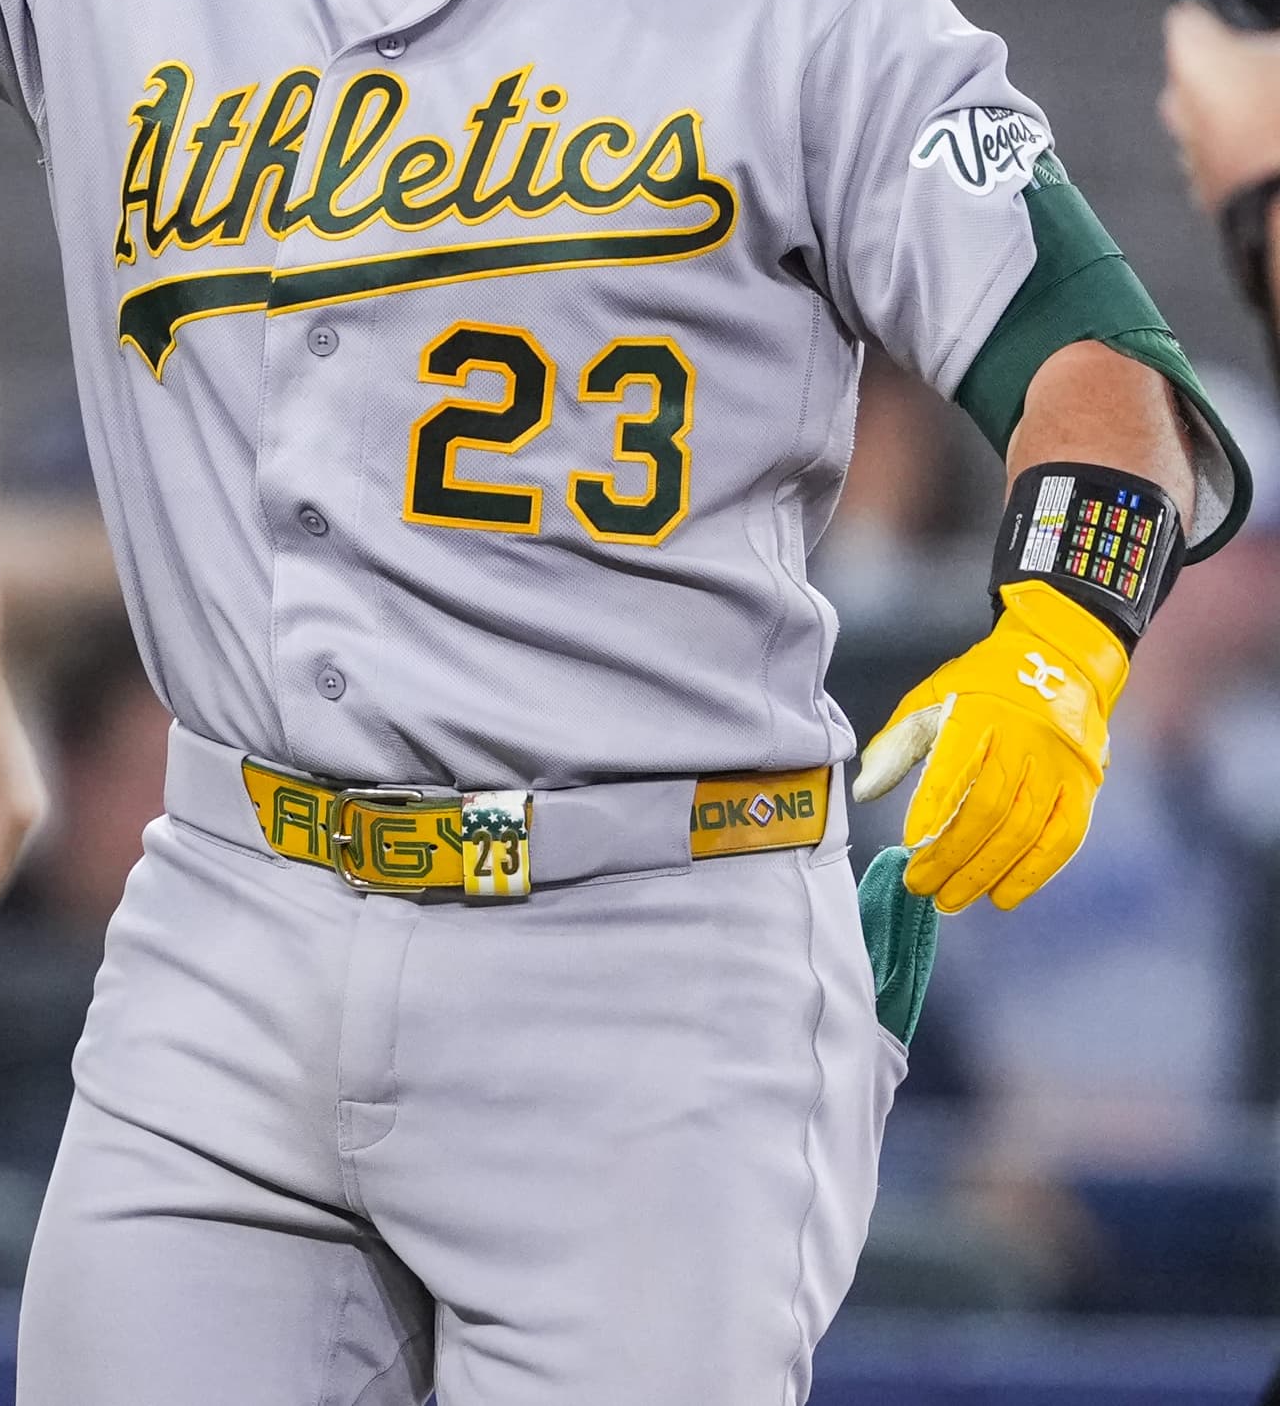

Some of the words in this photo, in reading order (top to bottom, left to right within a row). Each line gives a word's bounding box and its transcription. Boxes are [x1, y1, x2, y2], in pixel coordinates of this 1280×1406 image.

[115, 59, 737, 270] Athletics
[918, 107, 1042, 187] Vegas
[402, 319, 696, 546] 23
[472, 829, 519, 877] 23
